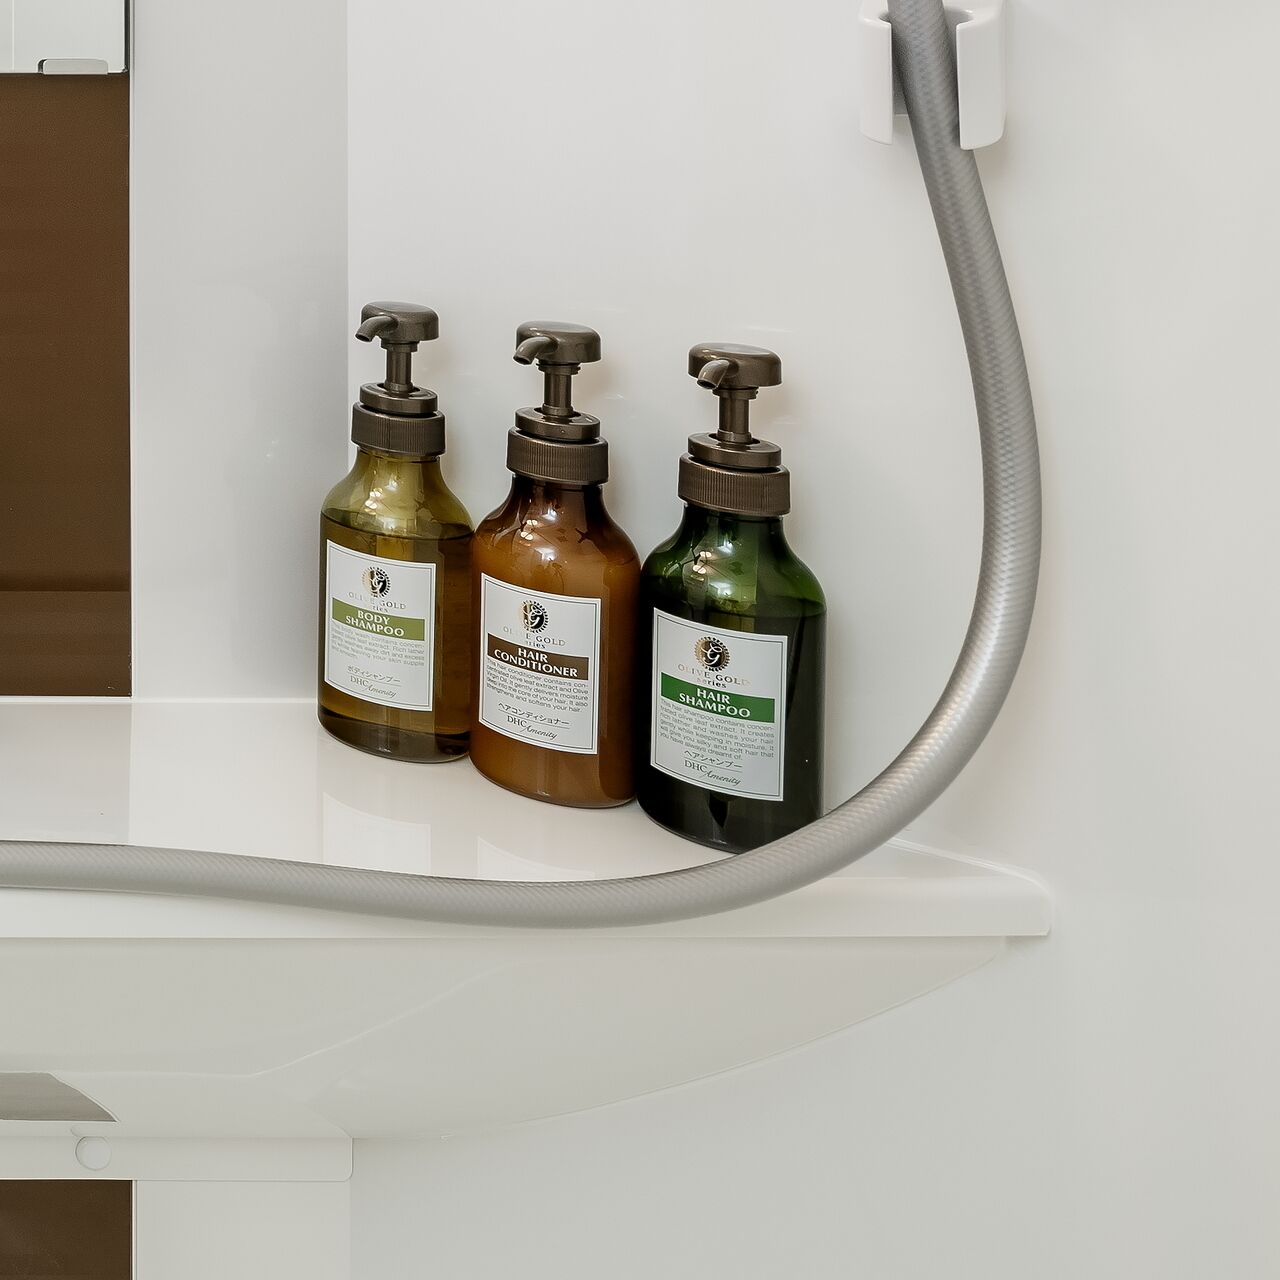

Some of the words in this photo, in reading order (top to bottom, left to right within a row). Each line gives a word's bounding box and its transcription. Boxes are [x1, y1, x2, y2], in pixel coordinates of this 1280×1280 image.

[345, 616, 404, 637] SHAMPOO
[357, 610, 390, 625] BODY
[535, 635, 566, 646] GOLD
[494, 649, 577, 677] CONDITIONER
[518, 647, 548, 663] HAIR
[350, 675, 369, 688] DHC
[679, 692, 751, 718] SHAMPOO
[697, 688, 730, 704] HAIR
[498, 702, 570, 725] ヘアコンディショナー
[507, 715, 527, 728] DHC
[520, 725, 557, 739] Amenity
[684, 749, 743, 768] ヘアシャンプー
[684, 759, 708, 772] DHC
[706, 770, 741, 786] Amenity
